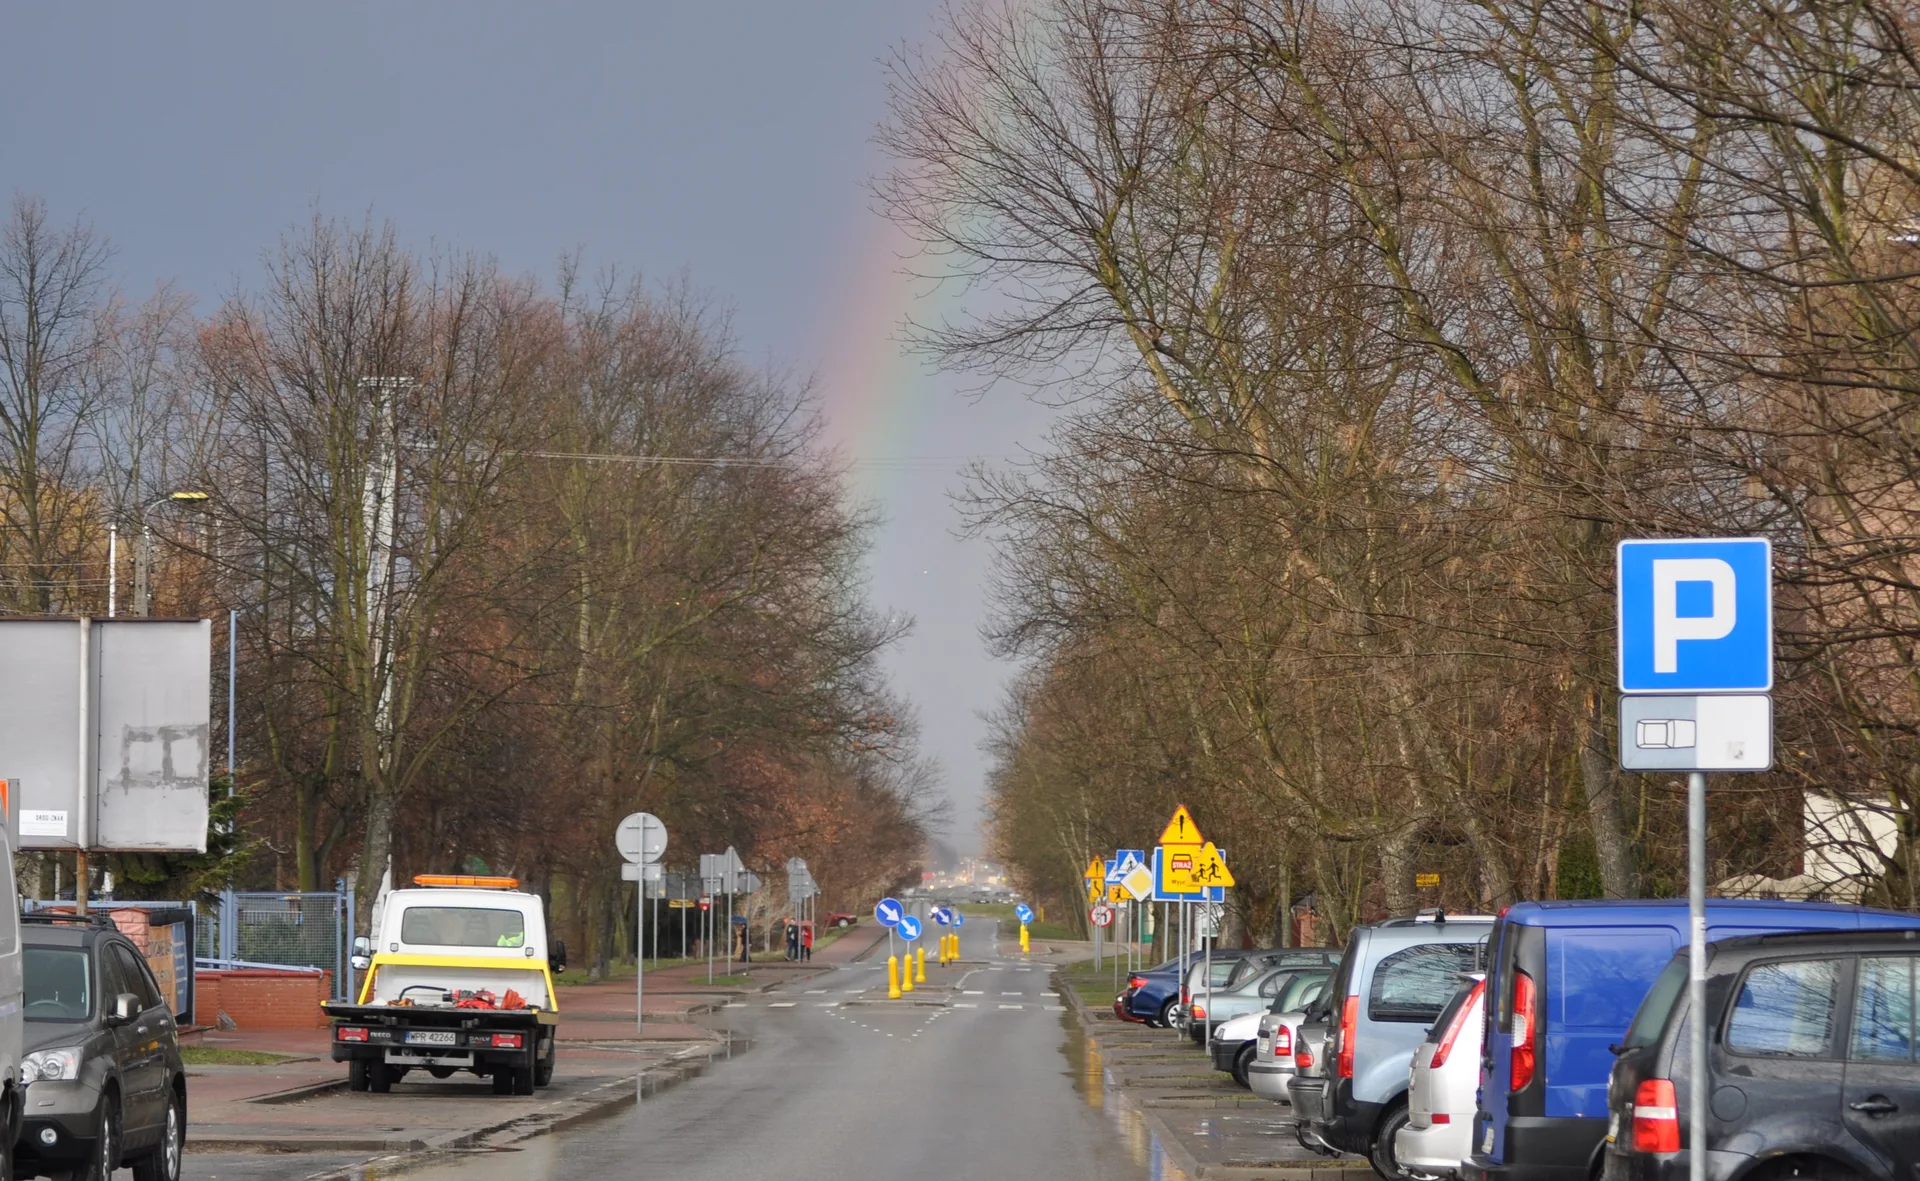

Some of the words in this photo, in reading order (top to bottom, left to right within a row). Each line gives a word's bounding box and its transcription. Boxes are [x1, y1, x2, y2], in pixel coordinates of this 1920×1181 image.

[1653, 558, 1737, 674] P
[411, 1032, 427, 1042] WPR
[429, 1033, 455, 1042] 42266
